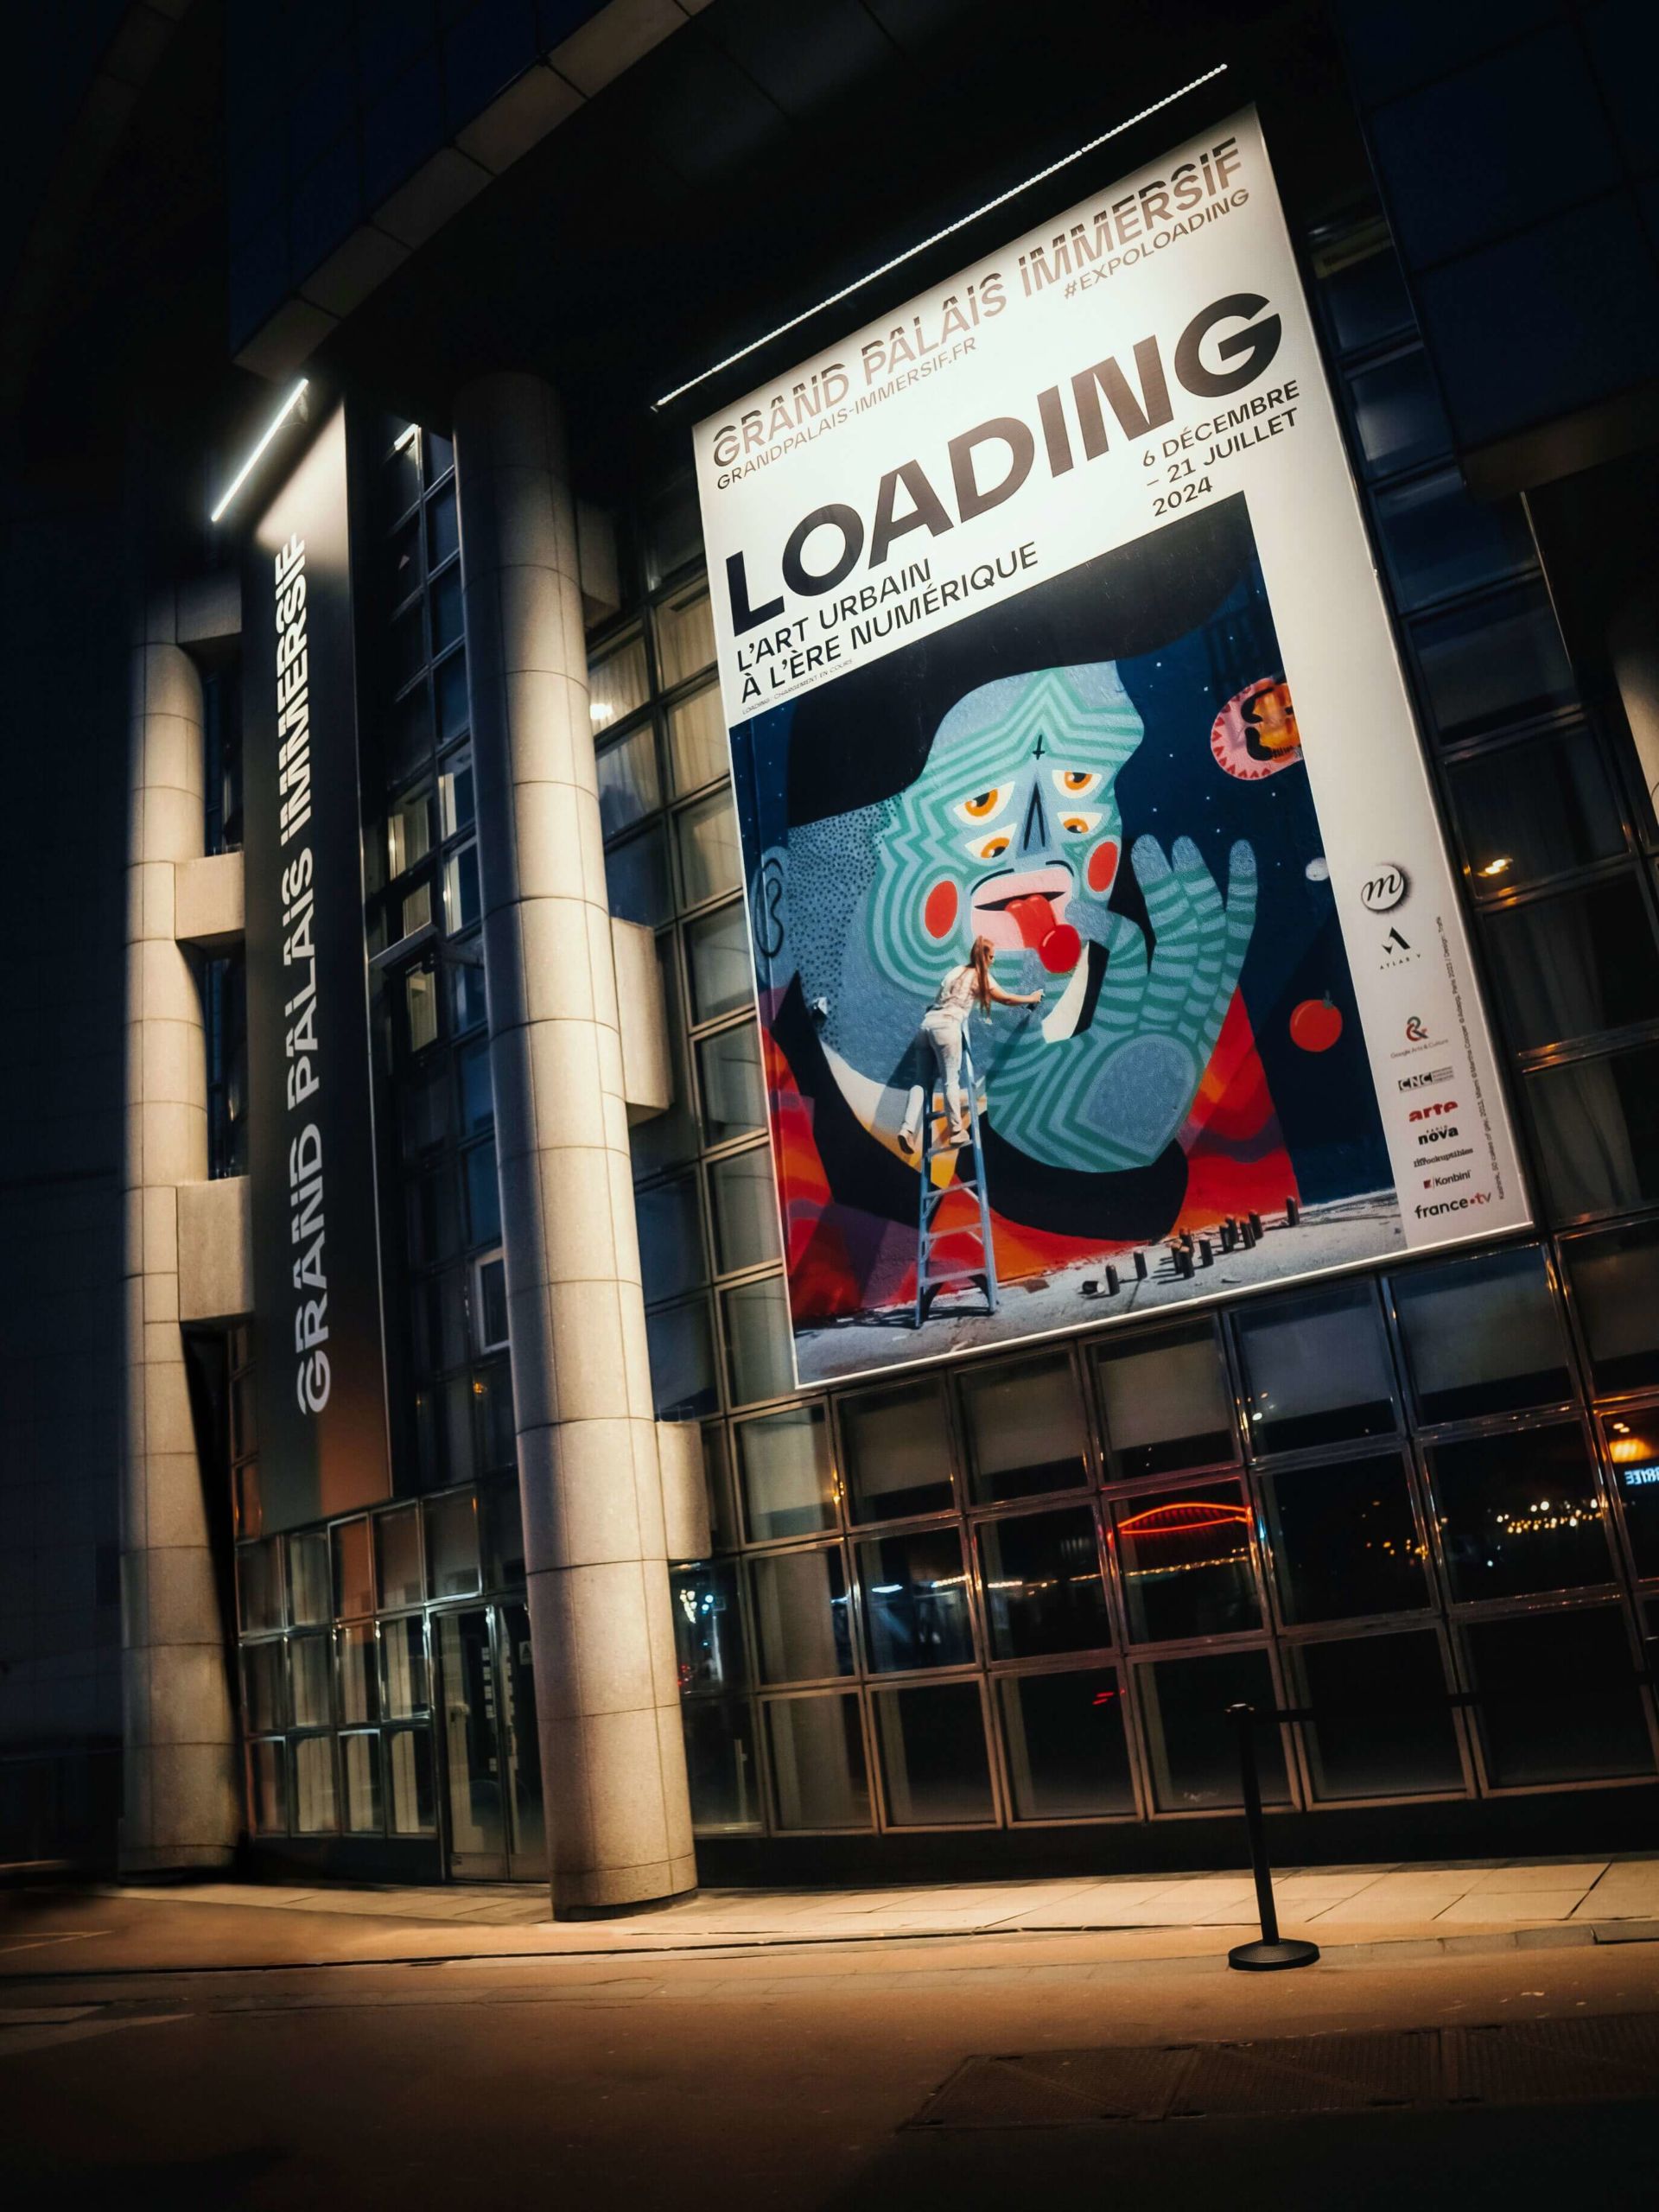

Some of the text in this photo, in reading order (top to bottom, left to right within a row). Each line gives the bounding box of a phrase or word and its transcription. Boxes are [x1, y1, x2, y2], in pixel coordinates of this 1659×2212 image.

[1064, 188, 1249, 300] #EXPOLOADING
[713, 137, 1242, 467] GRAND PALAIS IMMERSIF
[717, 337, 977, 490] GRANDPALAIS-IMMERSIF.FR
[1142, 379, 1300, 467] 6 DÉCEMBRE
[1166, 459, 1196, 484] 21
[1204, 407, 1298, 467] JUILLET
[726, 292, 1281, 637] LOADING
[1151, 476, 1213, 518] 2024
[741, 672, 761, 704] À
[850, 541, 1038, 650] NUMÉRIQUE
[818, 557, 931, 629] URBAIN
[275, 532, 332, 1414] GRAND PALAIS IMMERSIF
[1397, 1072, 1433, 1091] CNC
[1408, 1101, 1459, 1122] arte
[1418, 1127, 1459, 1146] nova
